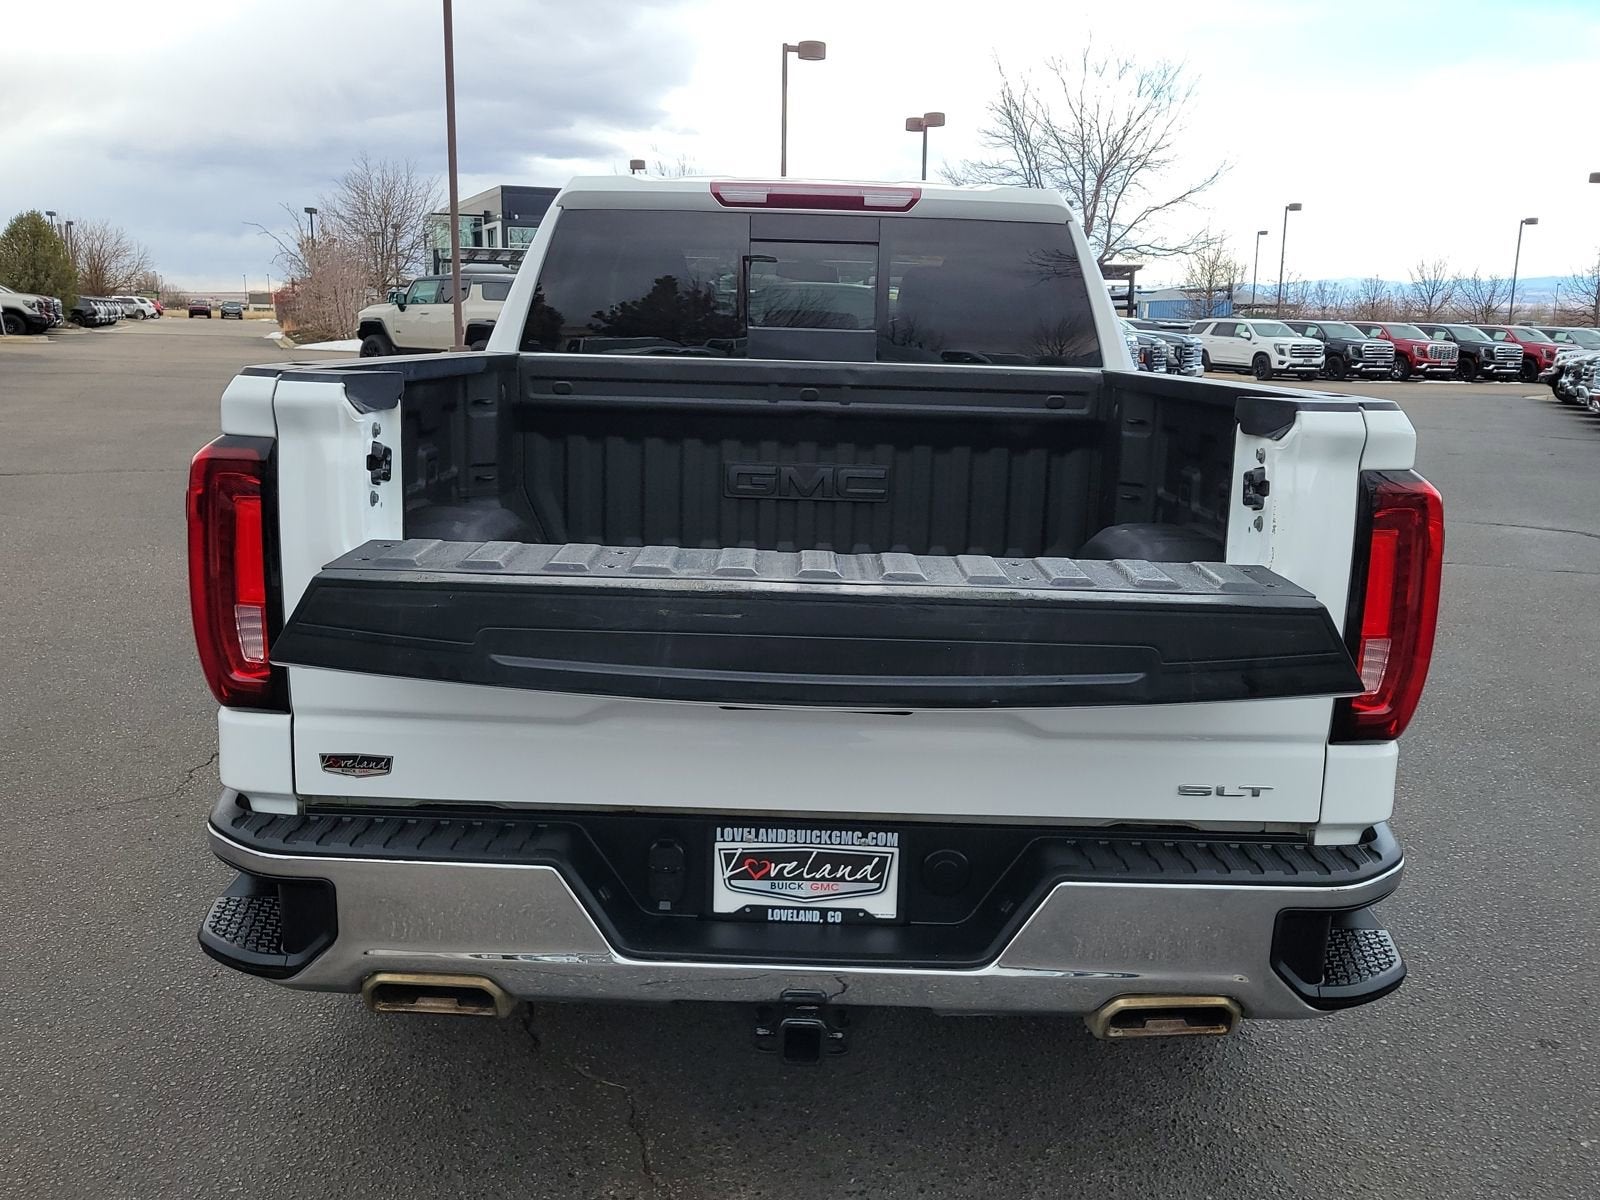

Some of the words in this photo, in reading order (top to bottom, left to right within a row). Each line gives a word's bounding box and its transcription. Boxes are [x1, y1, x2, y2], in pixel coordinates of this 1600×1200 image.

[728, 465, 888, 498] GMC
[1178, 785, 1274, 797] SLT
[716, 827, 899, 847] LOVELANDBUICKGMCCOM
[770, 881, 804, 891] BUICK
[810, 883, 839, 891] GMC
[767, 908, 824, 923] LOVELAND,
[827, 911, 842, 923] CO
